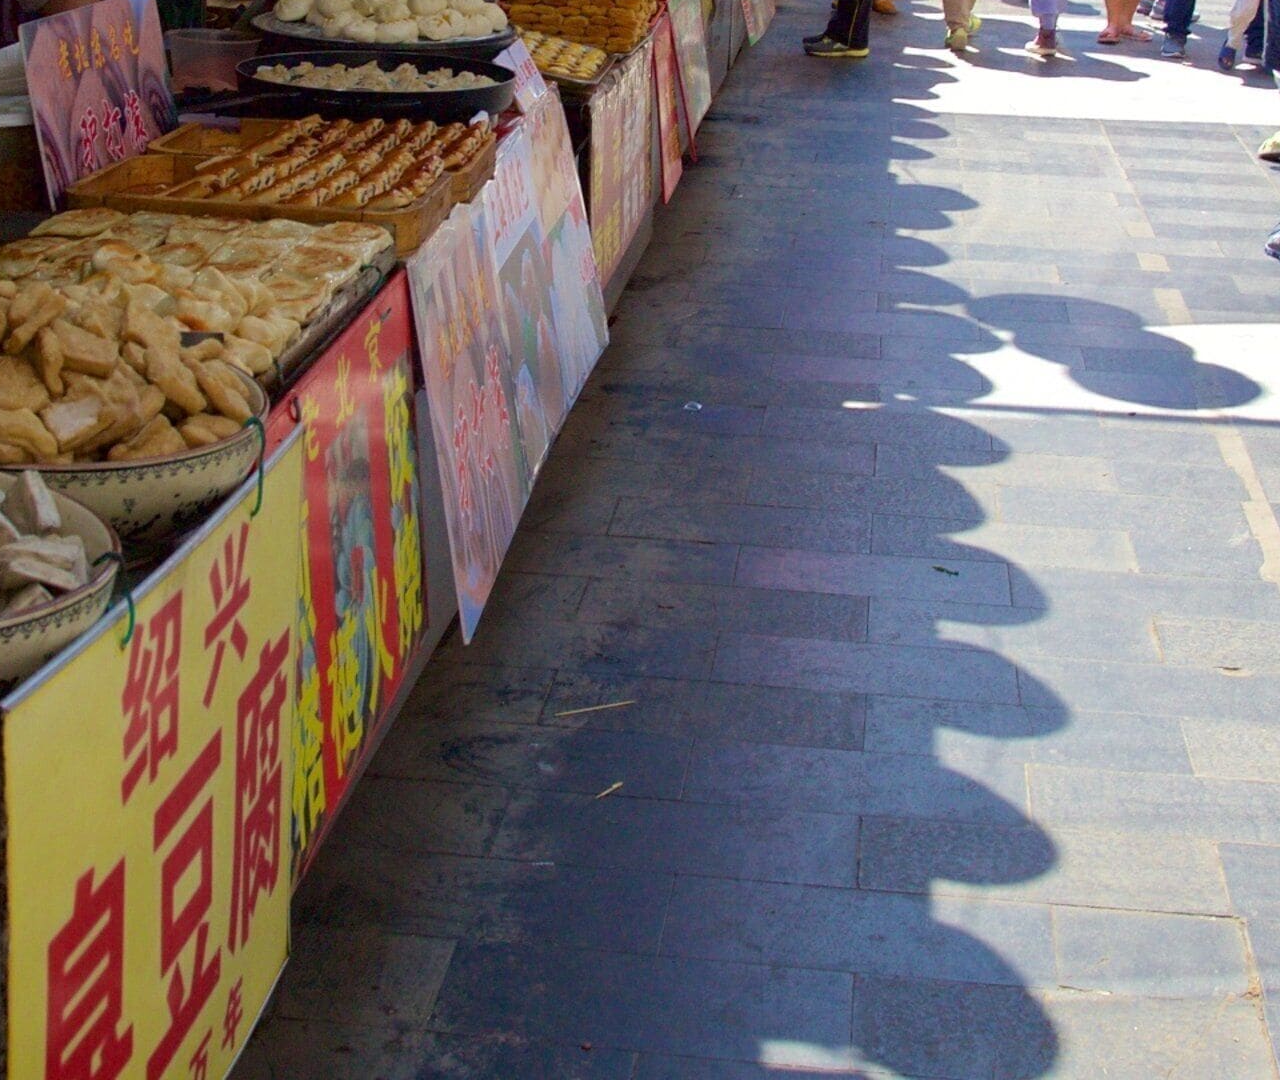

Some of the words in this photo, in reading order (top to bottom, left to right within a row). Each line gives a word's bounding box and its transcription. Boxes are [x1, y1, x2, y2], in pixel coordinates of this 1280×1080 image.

[302, 320, 381, 462] 老北京
[122, 522, 250, 806] 绍兴
[45, 626, 291, 1080] 臭豆腐
